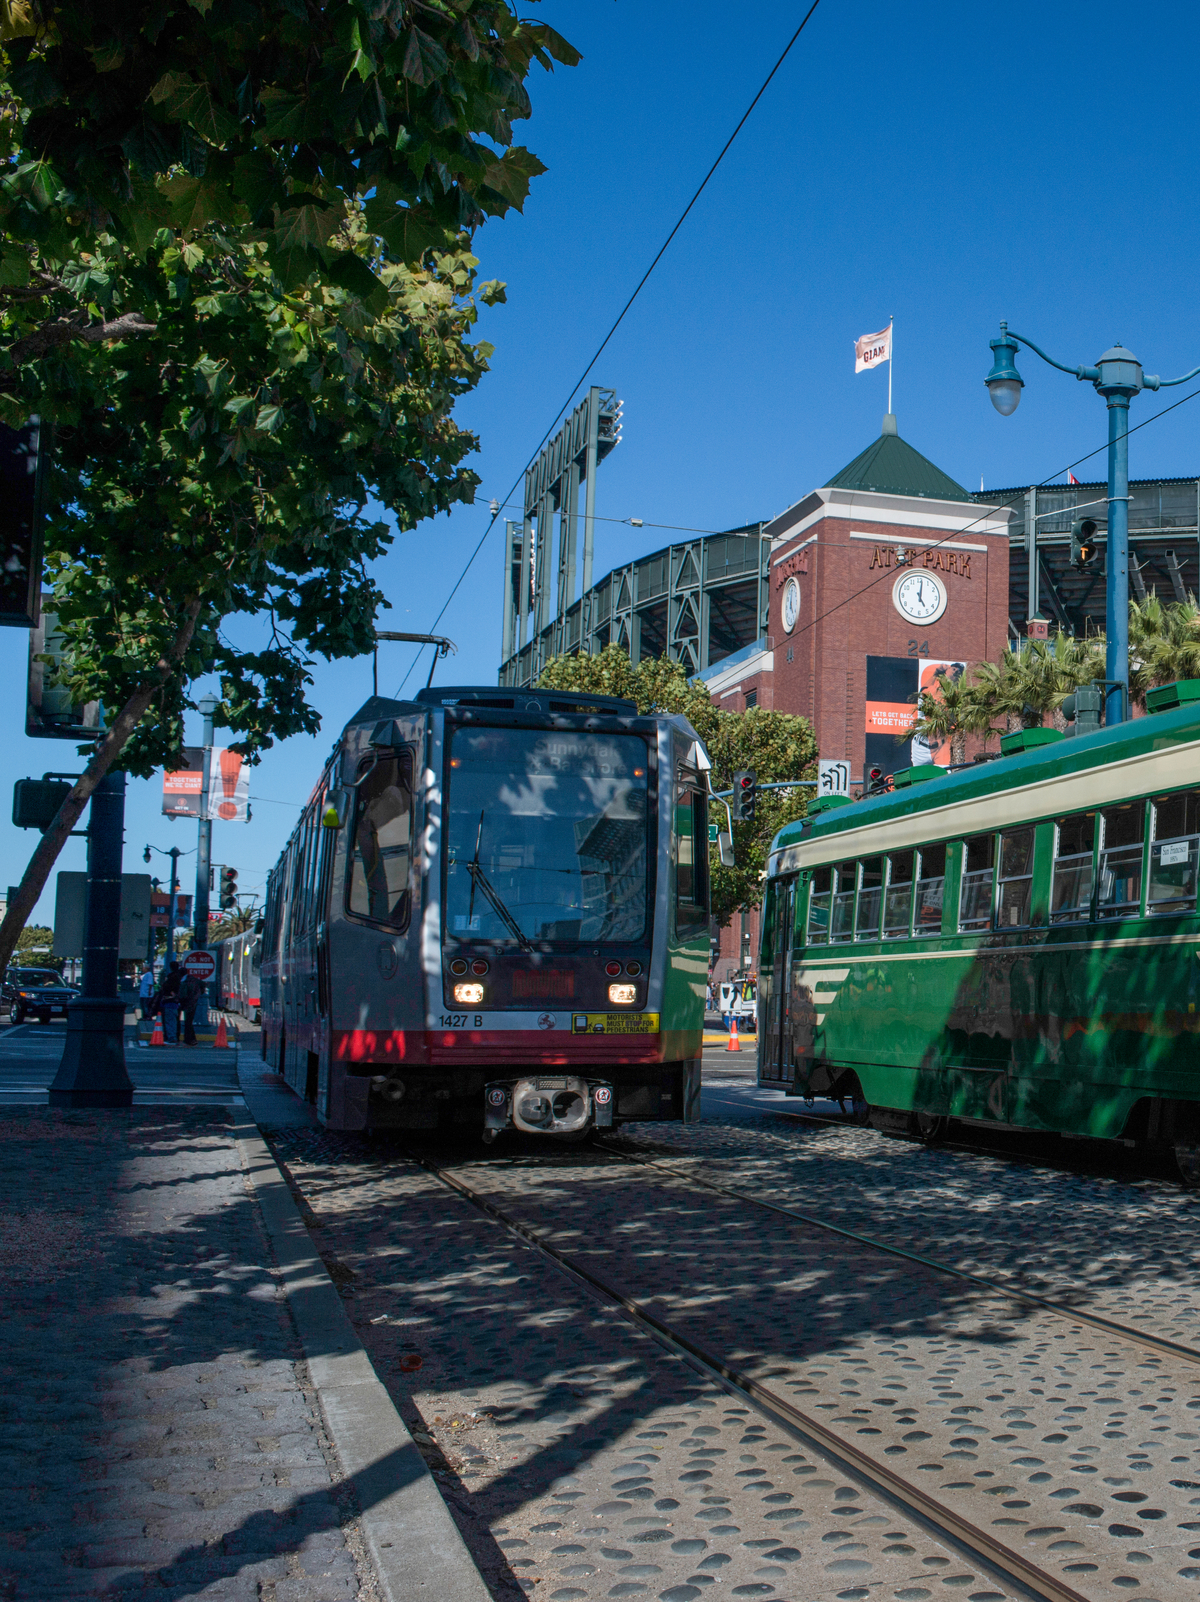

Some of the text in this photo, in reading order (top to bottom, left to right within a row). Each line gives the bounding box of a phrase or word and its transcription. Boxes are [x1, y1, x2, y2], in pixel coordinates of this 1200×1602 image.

[922, 551, 971, 579] PARK
[908, 640, 930, 657] 24
[872, 717, 914, 728] TOGETHER
[439, 1015, 483, 1028] 1427 B
